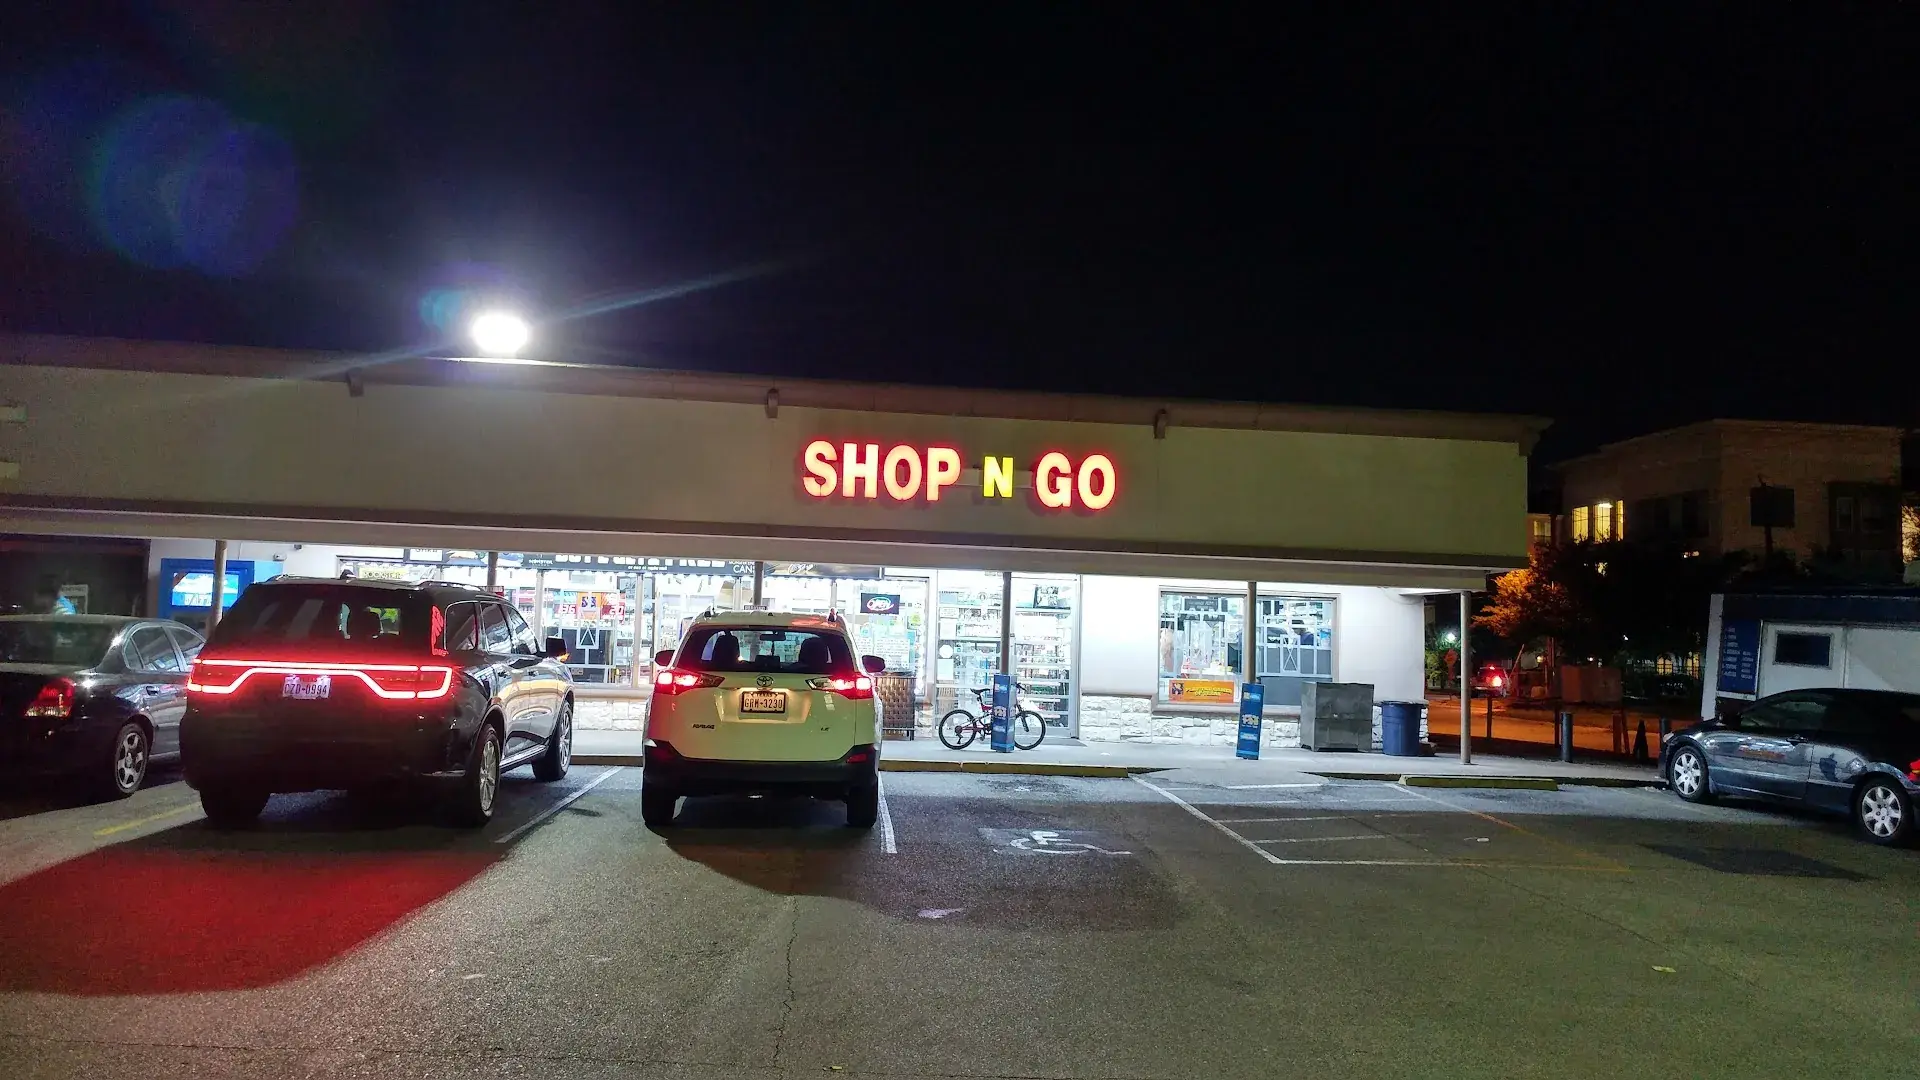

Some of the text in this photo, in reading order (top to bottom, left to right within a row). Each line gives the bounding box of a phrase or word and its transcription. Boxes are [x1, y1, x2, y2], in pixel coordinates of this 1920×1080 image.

[803, 440, 1116, 510] SHOP N GO
